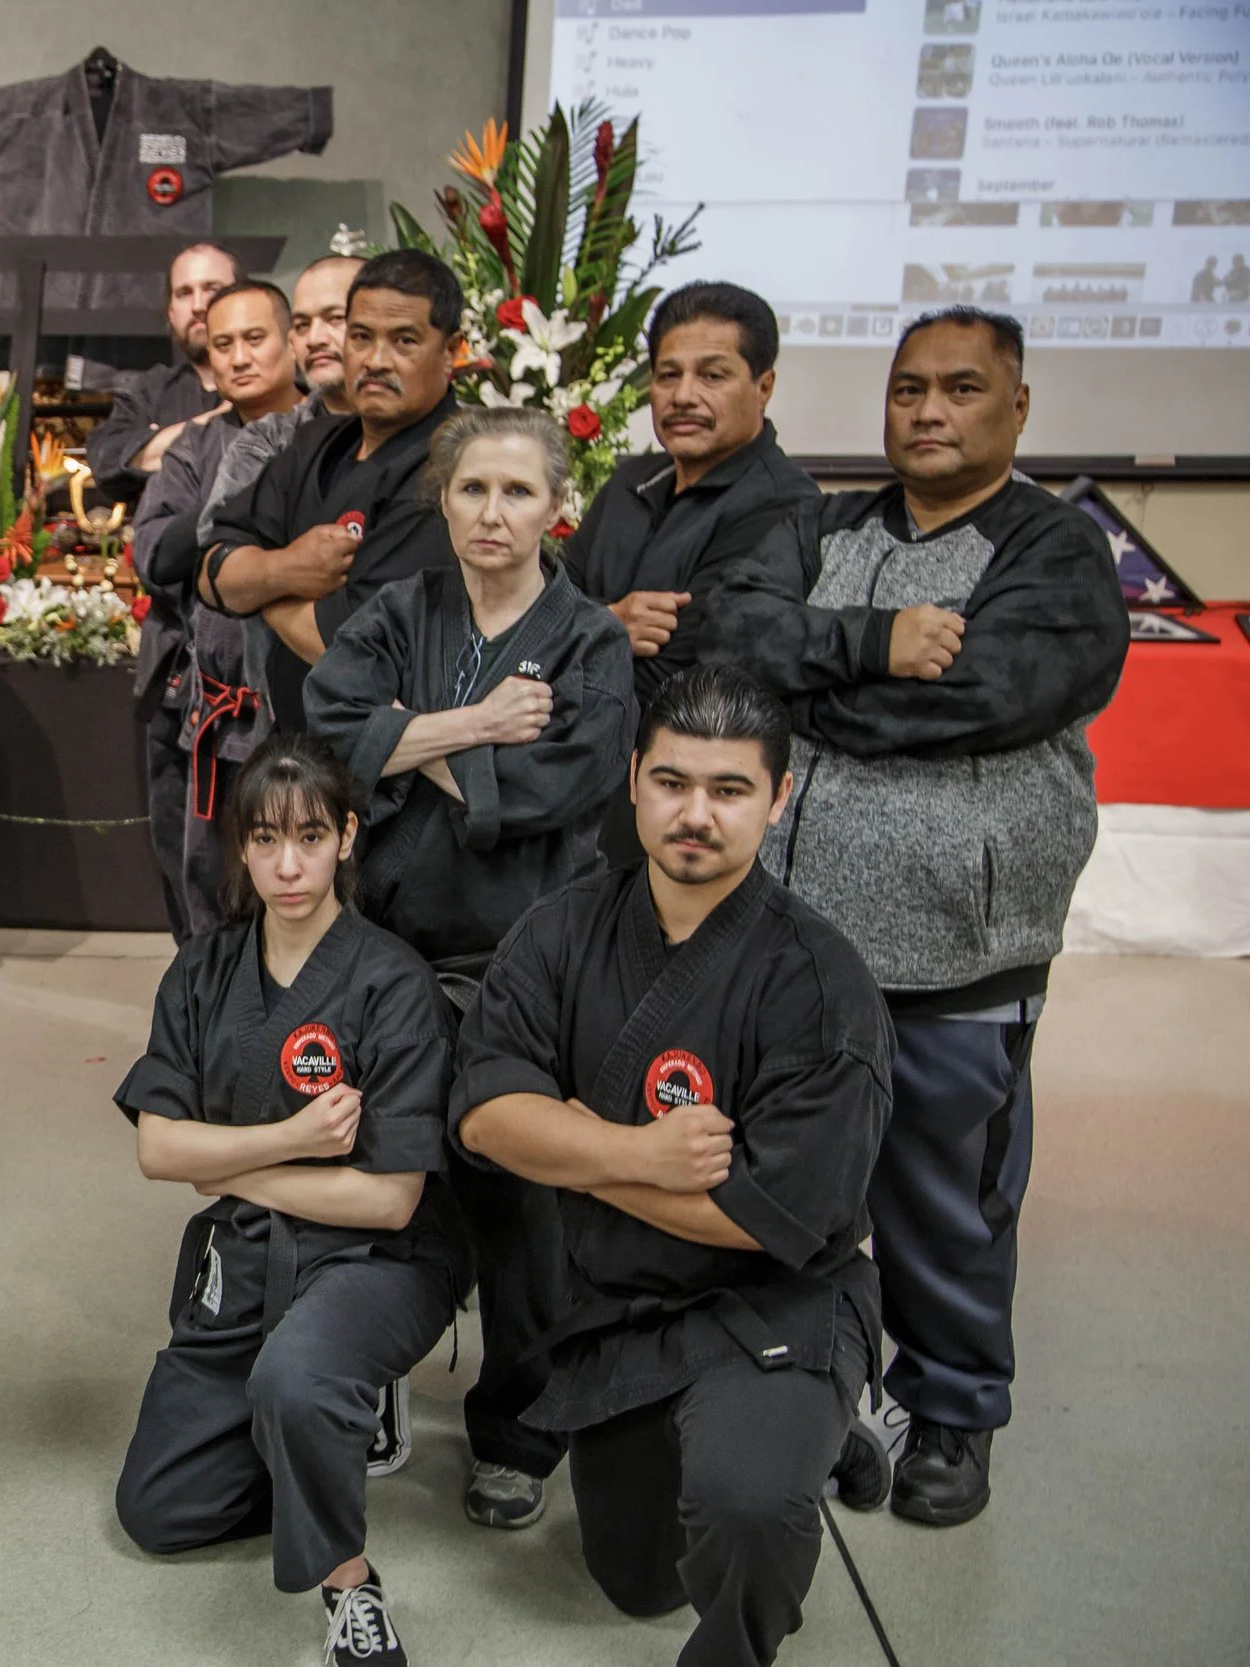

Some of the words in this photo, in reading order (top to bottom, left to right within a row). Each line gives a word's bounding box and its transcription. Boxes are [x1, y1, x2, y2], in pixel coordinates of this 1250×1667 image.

[991, 53, 1051, 68] Queen's
[1179, 50, 1239, 66] Version)
[292, 1055, 337, 1066] VACAVILLE
[299, 1082, 330, 1093] REYES
[656, 1079, 701, 1103] VACAVILLE
